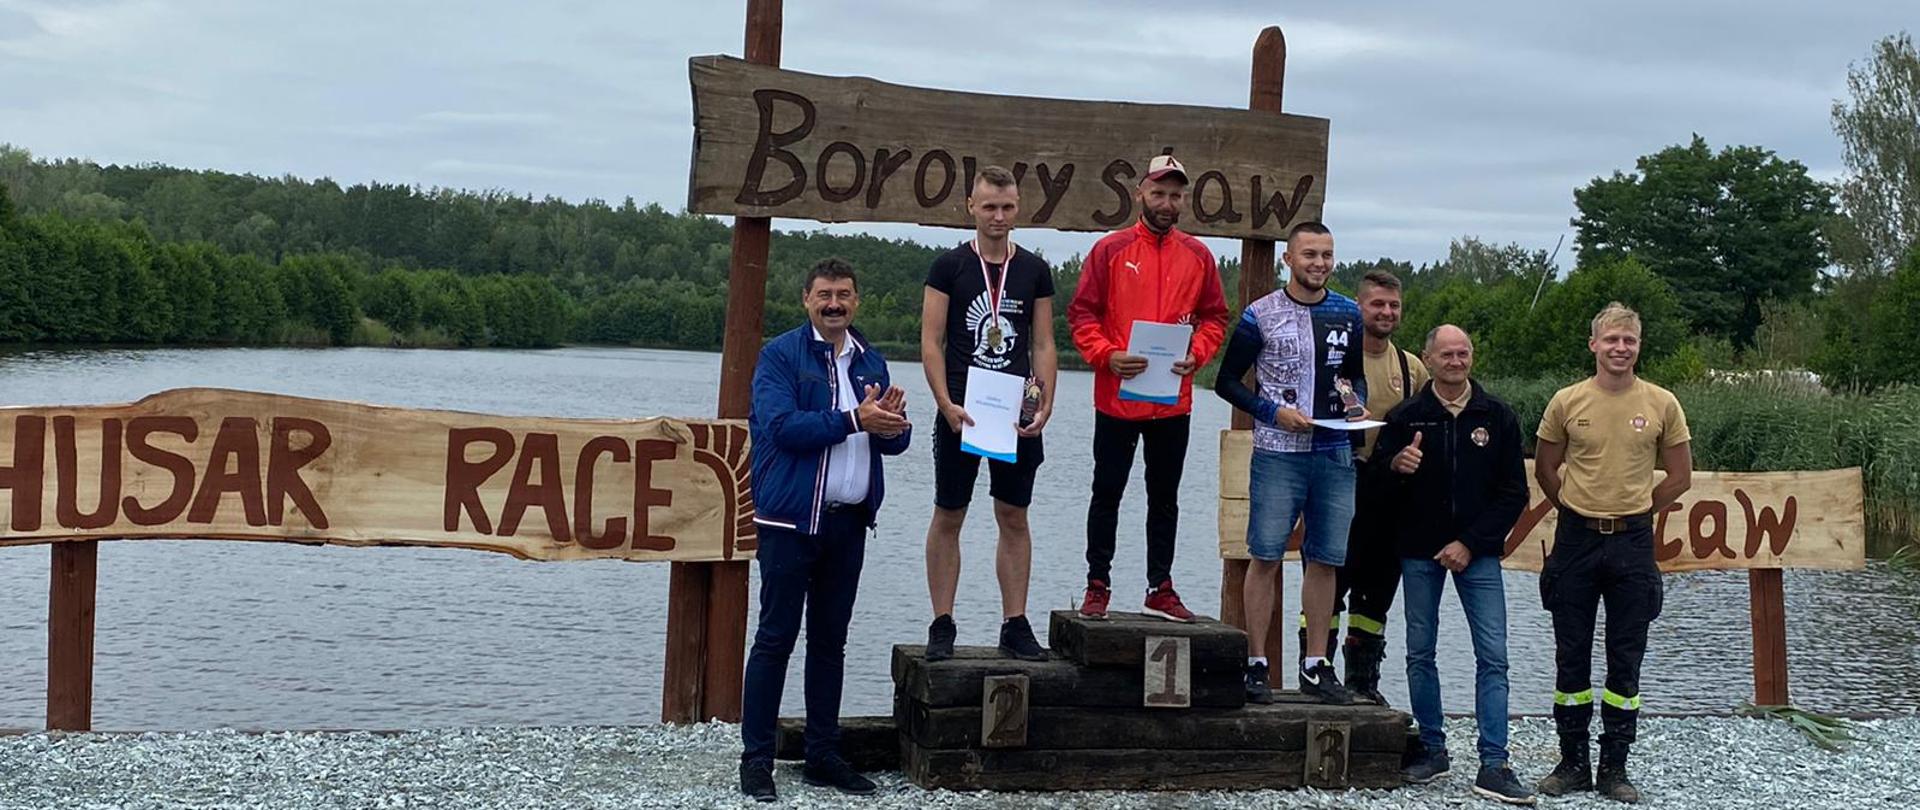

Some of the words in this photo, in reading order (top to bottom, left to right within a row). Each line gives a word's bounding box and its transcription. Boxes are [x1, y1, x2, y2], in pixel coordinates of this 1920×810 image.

[1092, 147, 1314, 229] saw
[1165, 157, 1177, 168] A
[1326, 330, 1348, 346] 44
[0, 415, 329, 531] HUSAR
[444, 426, 677, 551] RACE
[1653, 488, 1797, 562] taw
[1149, 639, 1188, 704] 1
[989, 683, 1026, 741] 2
[1309, 729, 1345, 785] 3
